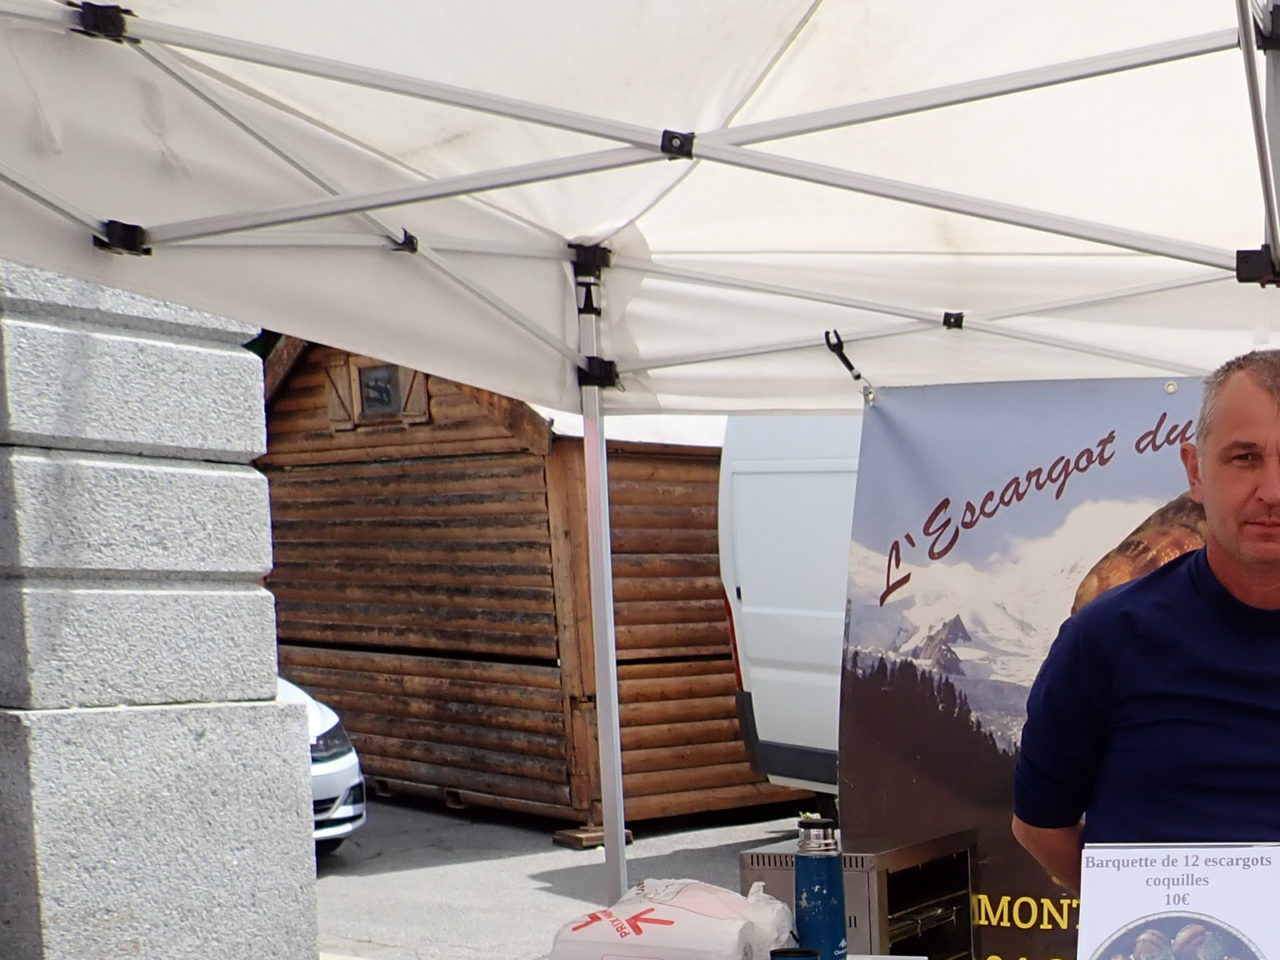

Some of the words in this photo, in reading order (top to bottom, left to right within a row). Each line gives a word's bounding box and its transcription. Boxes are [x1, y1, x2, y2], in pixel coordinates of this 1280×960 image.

[880, 430, 1116, 607] L'Escargot
[1135, 412, 1195, 454] du
[1085, 855, 1157, 872] Barquette
[1161, 854, 1178, 867] de
[1184, 855, 1199, 867] 12
[1204, 855, 1272, 869] escargots
[1145, 874, 1209, 889] coquilles
[1165, 893, 1190, 906] 10€
